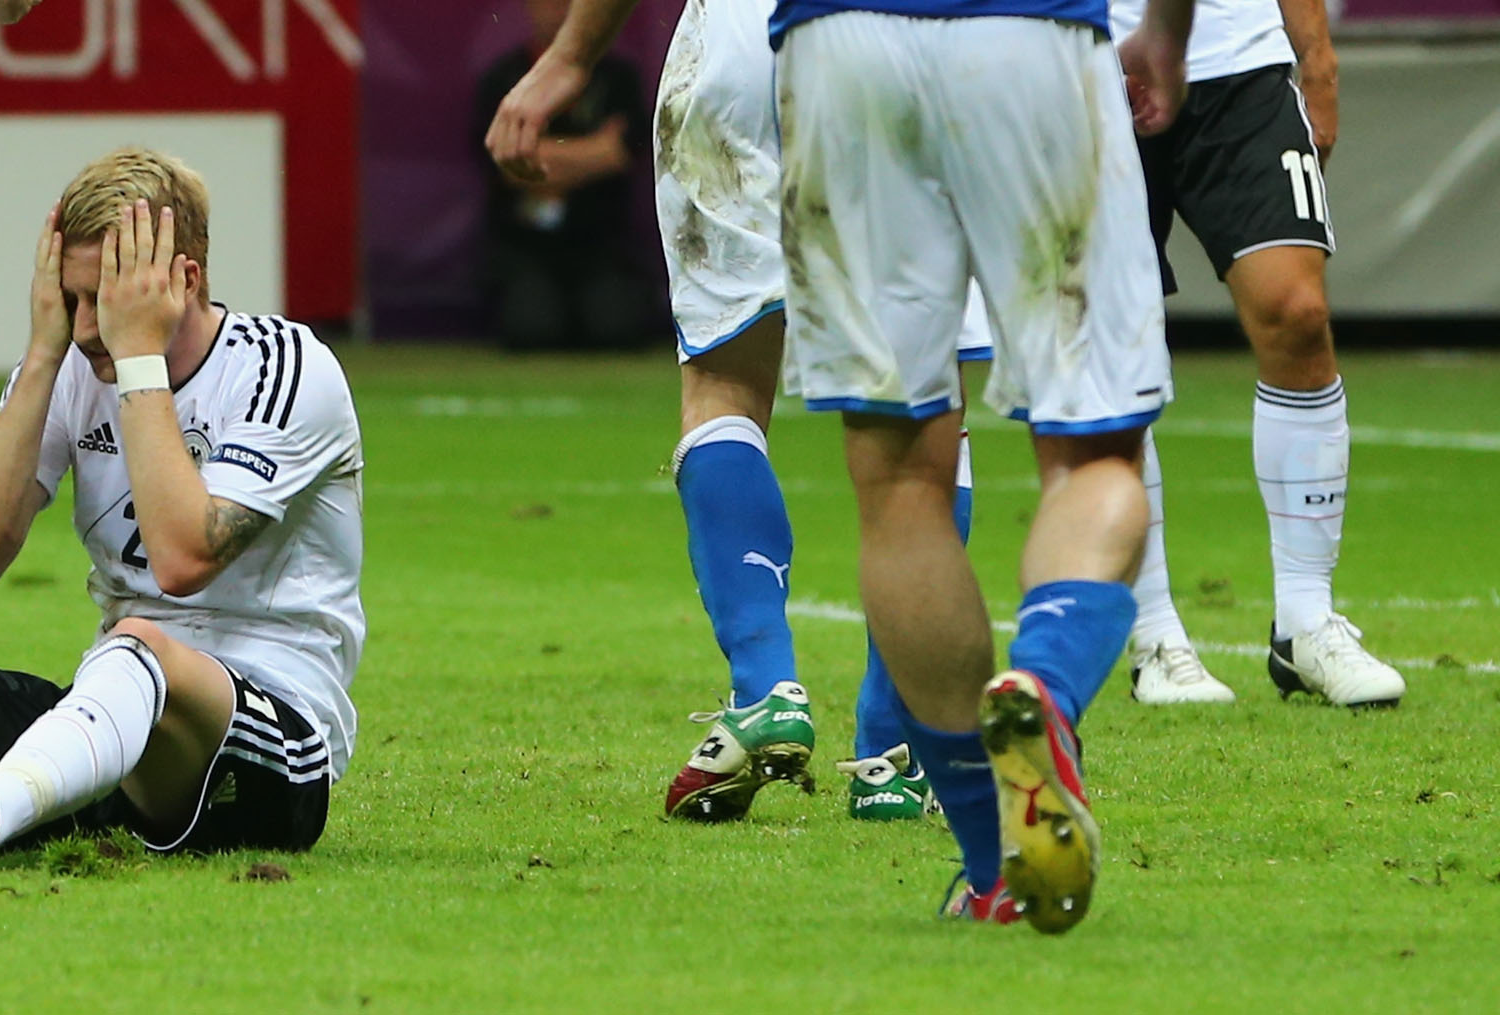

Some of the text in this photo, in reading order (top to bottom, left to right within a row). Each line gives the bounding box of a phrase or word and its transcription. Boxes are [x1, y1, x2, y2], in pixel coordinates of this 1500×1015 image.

[1281, 149, 1326, 223] 11
[77, 439, 119, 456] adidas
[223, 448, 275, 478] RESPECT
[856, 791, 905, 809] lotto
